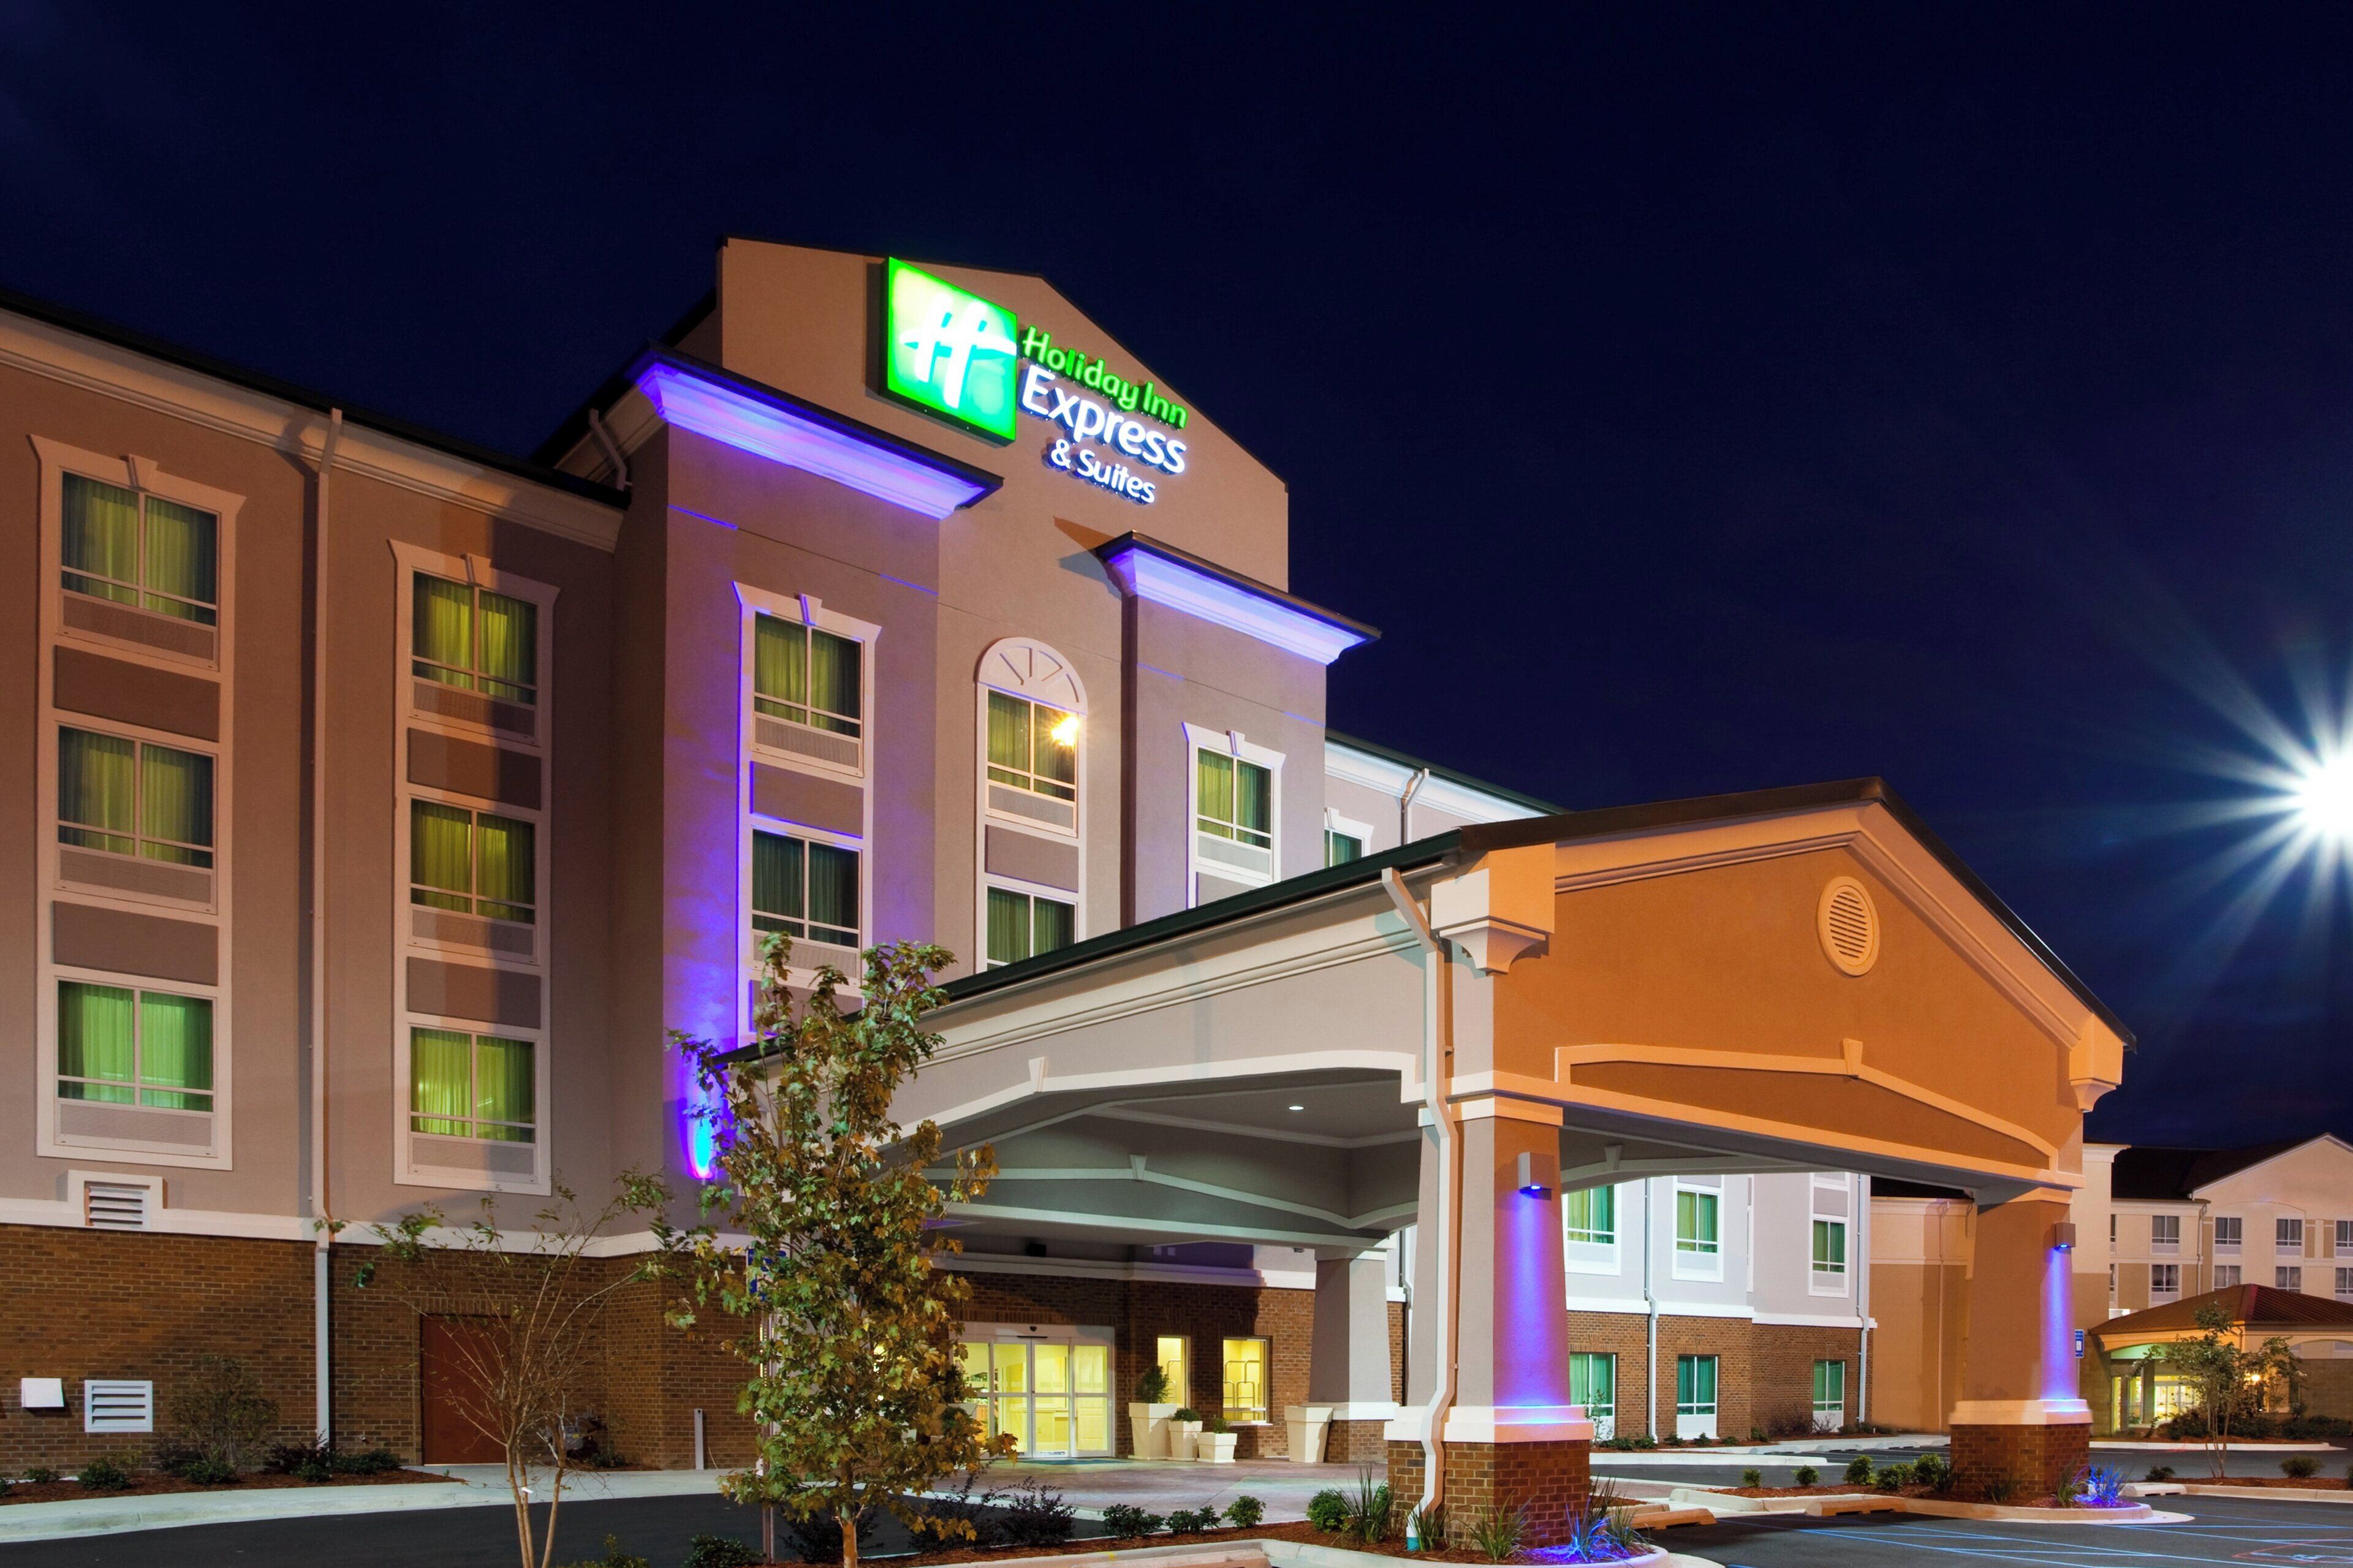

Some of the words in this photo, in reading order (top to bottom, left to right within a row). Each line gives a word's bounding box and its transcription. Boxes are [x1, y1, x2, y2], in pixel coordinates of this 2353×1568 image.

[1021, 325, 1139, 412] Holiday
[1142, 381, 1188, 429] Inn
[1021, 365, 1187, 474] Express
[1050, 438, 1071, 469] &
[1077, 449, 1156, 504] Suites
